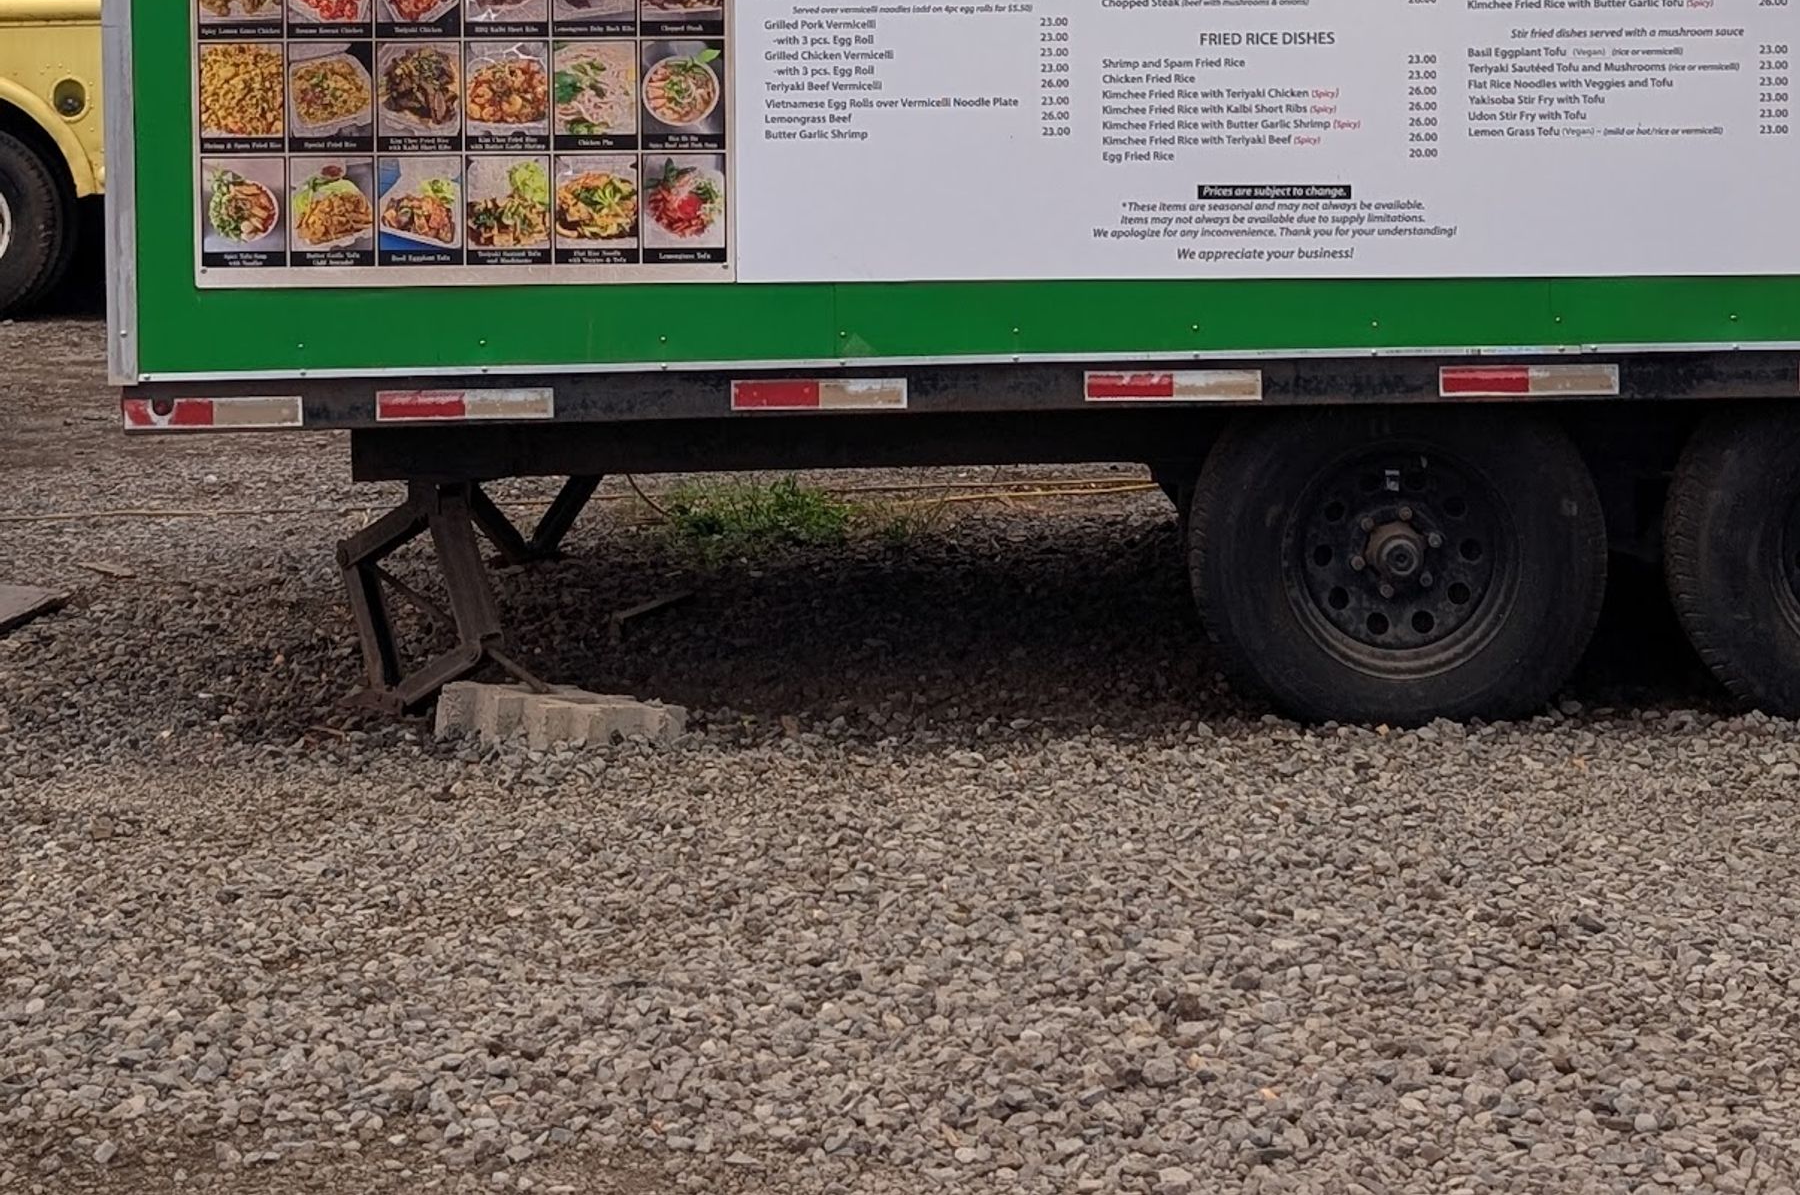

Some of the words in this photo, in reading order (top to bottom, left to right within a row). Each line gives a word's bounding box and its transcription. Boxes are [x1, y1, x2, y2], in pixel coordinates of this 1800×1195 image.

[764, 19, 799, 30] Grilled
[800, 19, 825, 30] Pork
[825, 19, 877, 30] Vermicelli
[1040, 17, 1069, 27] 23.00
[1200, 32, 1243, 46] FRIED
[1246, 32, 1279, 45] RICE
[1282, 31, 1336, 45] DISHES
[1510, 28, 1529, 39] Stir
[1530, 28, 1555, 39] fried
[1555, 28, 1588, 38] dishes
[1589, 27, 1624, 38] served
[1624, 27, 1648, 37] with
[1648, 29, 1657, 37] a
[1657, 26, 1714, 37] mushroom
[1715, 28, 1745, 37] sauce
[1102, 58, 1140, 71] Shrimp
[1141, 58, 1162, 68] and
[1163, 58, 1194, 70] Spam
[1195, 57, 1222, 68] Fried
[1224, 57, 1246, 68] Rice
[1407, 54, 1437, 64] 23.00
[1102, 104, 1147, 115] Kimchee
[1148, 104, 1176, 115] Fried
[1177, 104, 1199, 115] Rice
[1200, 104, 1225, 114] with
[1226, 103, 1253, 114] Kalbi
[1254, 103, 1284, 114] Short
[1285, 103, 1308, 114] Ribs
[1408, 101, 1438, 111] 26.00
[765, 114, 827, 126] Lemongrass
[829, 113, 853, 124] Beef
[1041, 110, 1070, 121] 26.00
[1468, 110, 1497, 121] Udon
[1499, 110, 1518, 121] Stir
[1519, 110, 1537, 123] Fry
[1538, 110, 1563, 121] with
[1563, 110, 1587, 121] Tofu
[1759, 108, 1789, 118] 23.00
[1202, 185, 1233, 197] Prices
[1233, 188, 1252, 197] are
[1252, 185, 1292, 199] subject
[1291, 186, 1304, 197] to
[1304, 185, 1348, 199] change.
[1158, 201, 1187, 212] items
[1188, 203, 1206, 212] are
[1207, 201, 1254, 212] seasonal
[1254, 201, 1276, 211] and
[1277, 202, 1301, 212] may
[1301, 201, 1320, 211] not
[1321, 199, 1358, 212] always
[1359, 200, 1373, 211] be
[1374, 199, 1425, 210] available.
[1177, 248, 1197, 260] We
[1198, 247, 1265, 262] appreciate
[1266, 250, 1296, 262] your
[1297, 247, 1355, 259] business!
